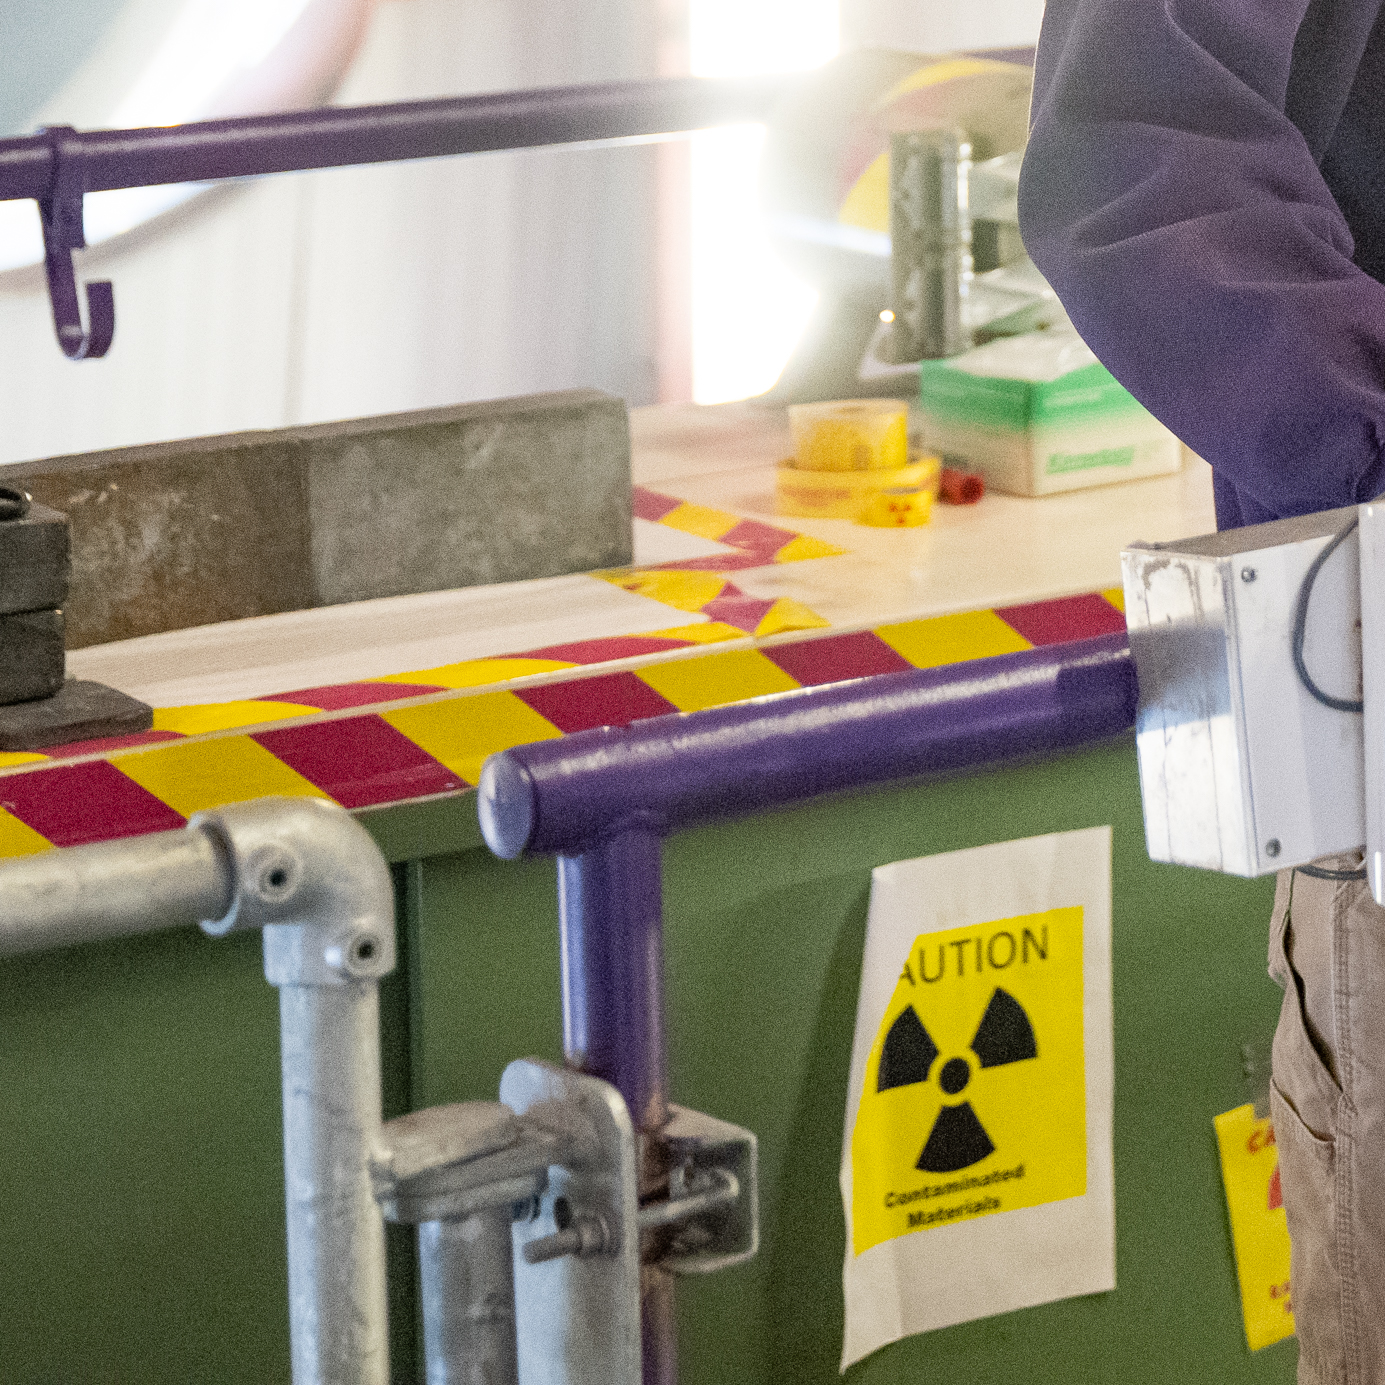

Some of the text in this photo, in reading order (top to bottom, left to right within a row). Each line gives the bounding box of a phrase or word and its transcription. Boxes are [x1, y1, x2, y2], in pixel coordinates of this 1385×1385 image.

[900, 924, 1048, 987] AUTION
[884, 1164, 1026, 1209] Contaminated
[907, 1195, 1001, 1228] Materials
